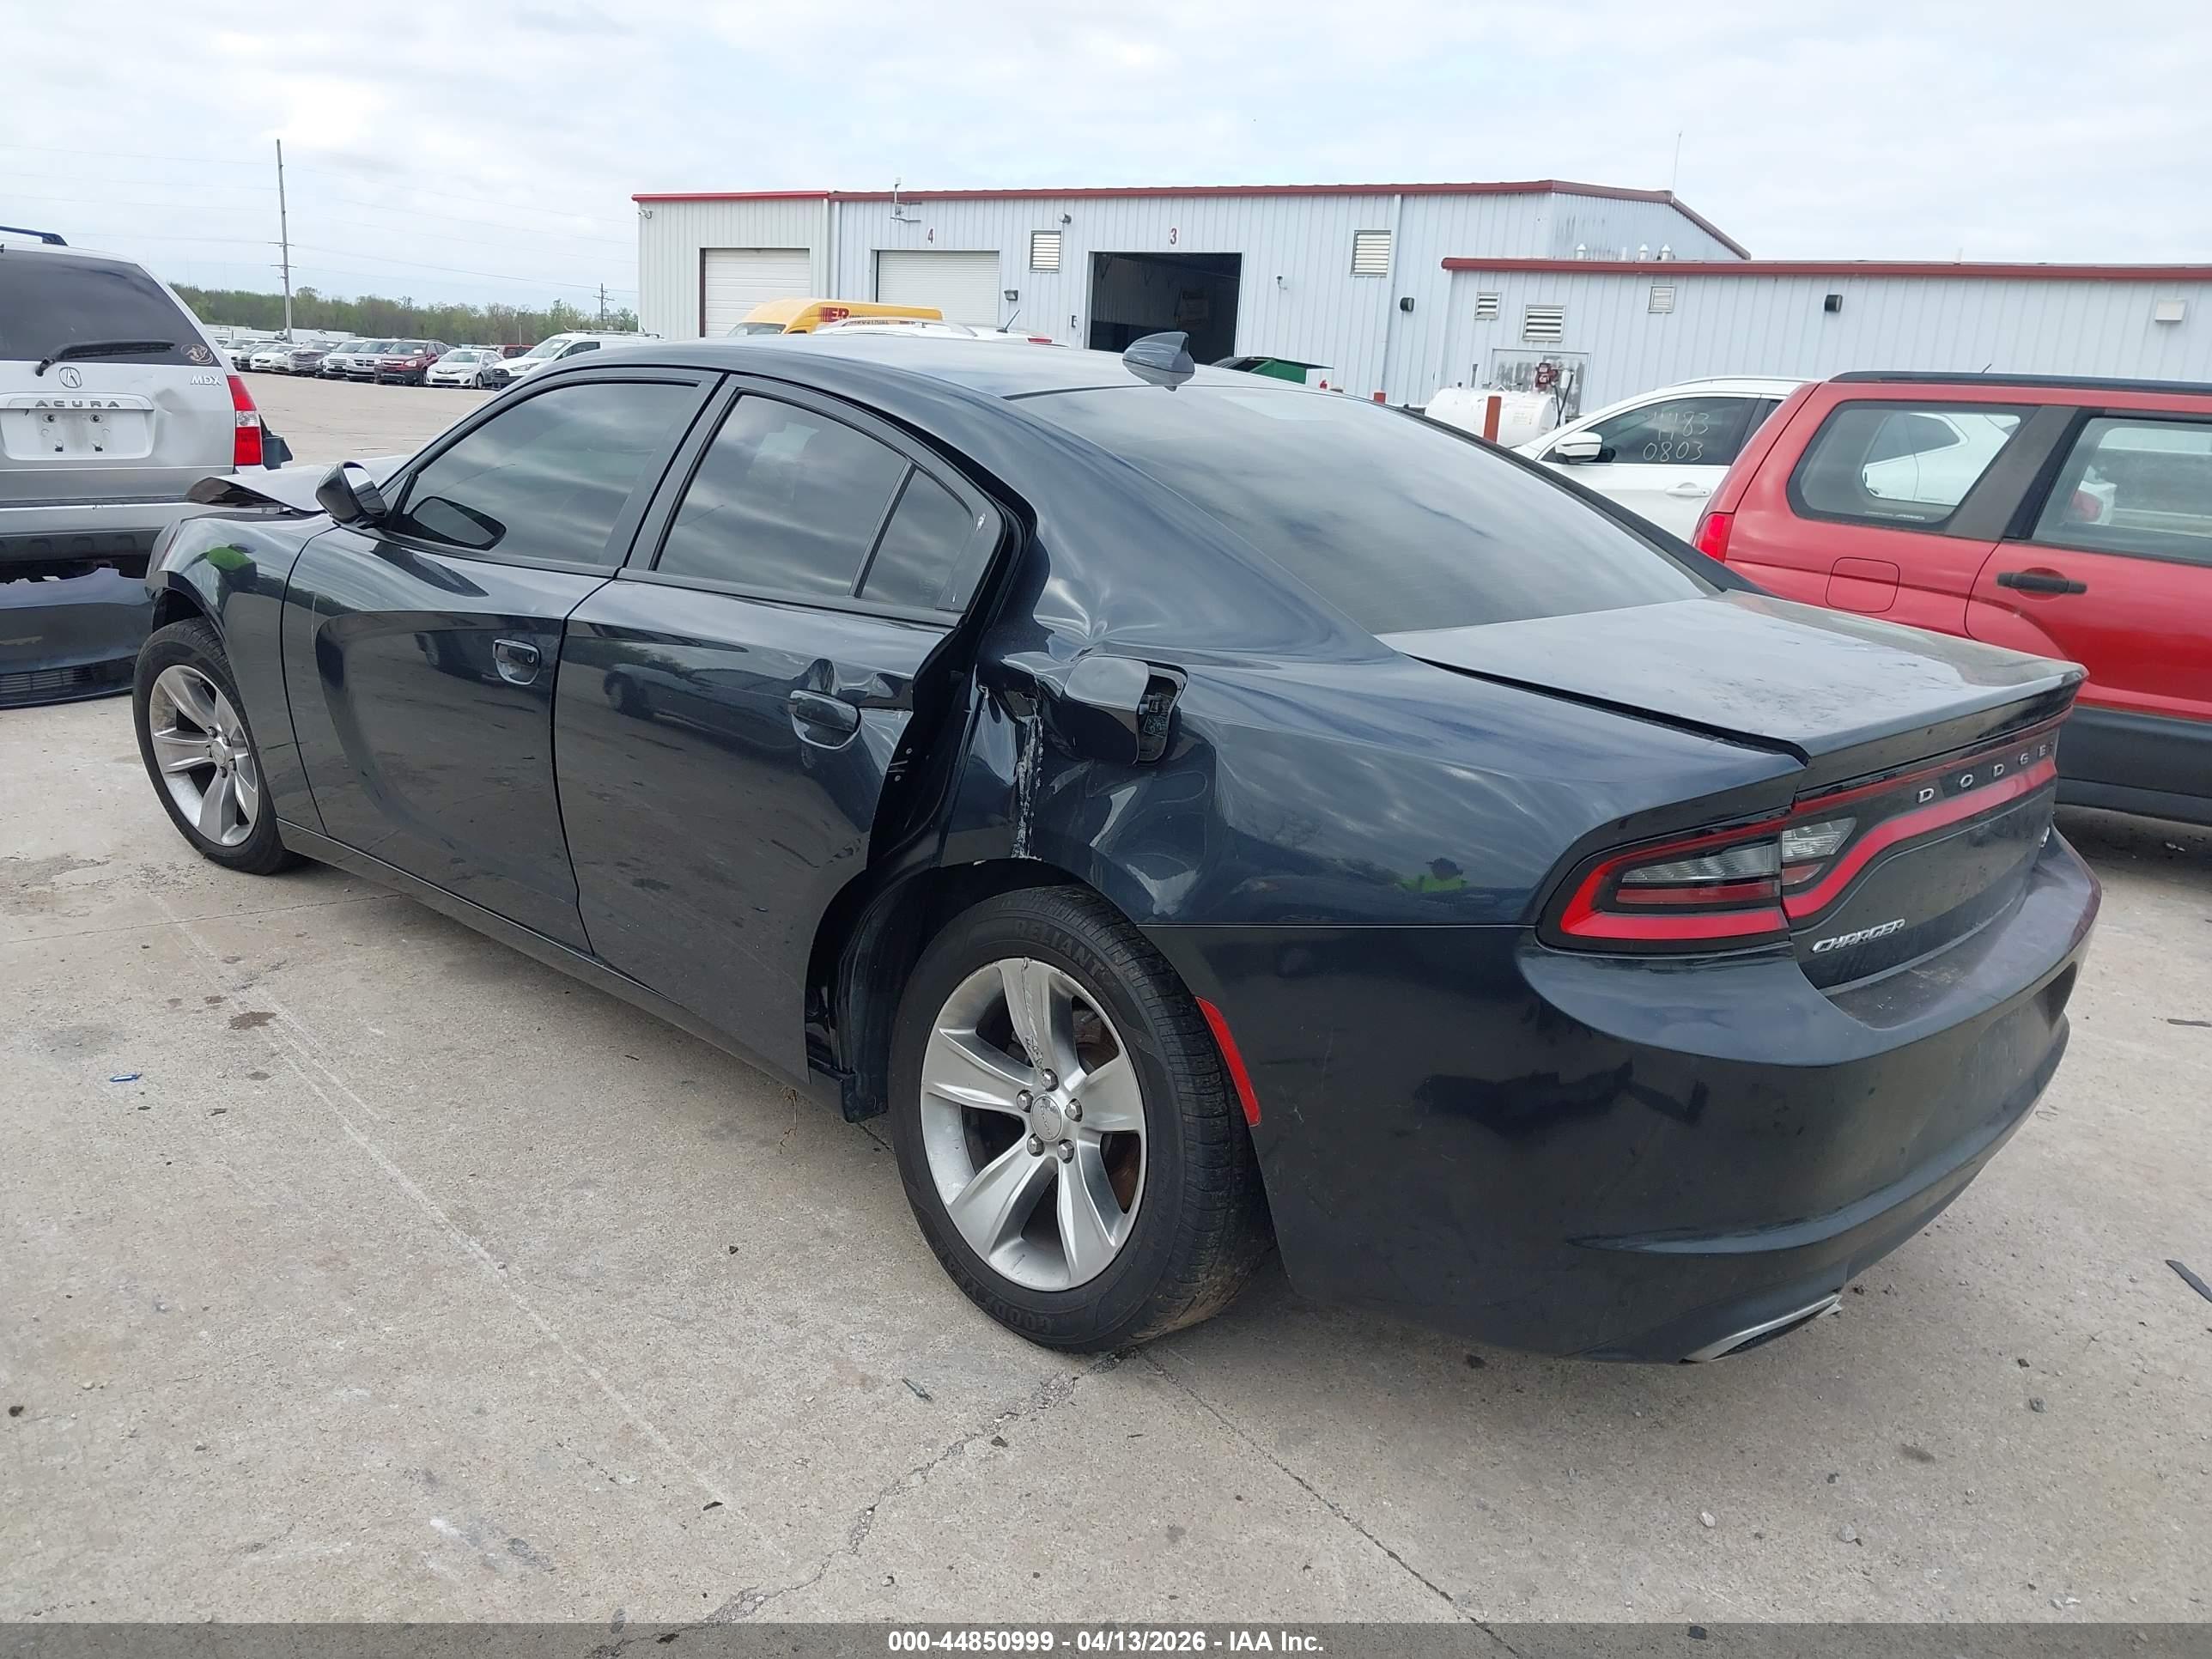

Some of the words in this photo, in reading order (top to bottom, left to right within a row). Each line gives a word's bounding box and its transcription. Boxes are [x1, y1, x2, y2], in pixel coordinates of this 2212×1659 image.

[927, 228, 934, 244] 4
[1170, 228, 1177, 245] 3
[190, 374, 222, 386] MDX
[35, 399, 119, 408] ACURA
[1643, 441, 1704, 462] 0803
[1917, 744, 2047, 804] DODGE
[1812, 918, 1905, 954] CHARGER
